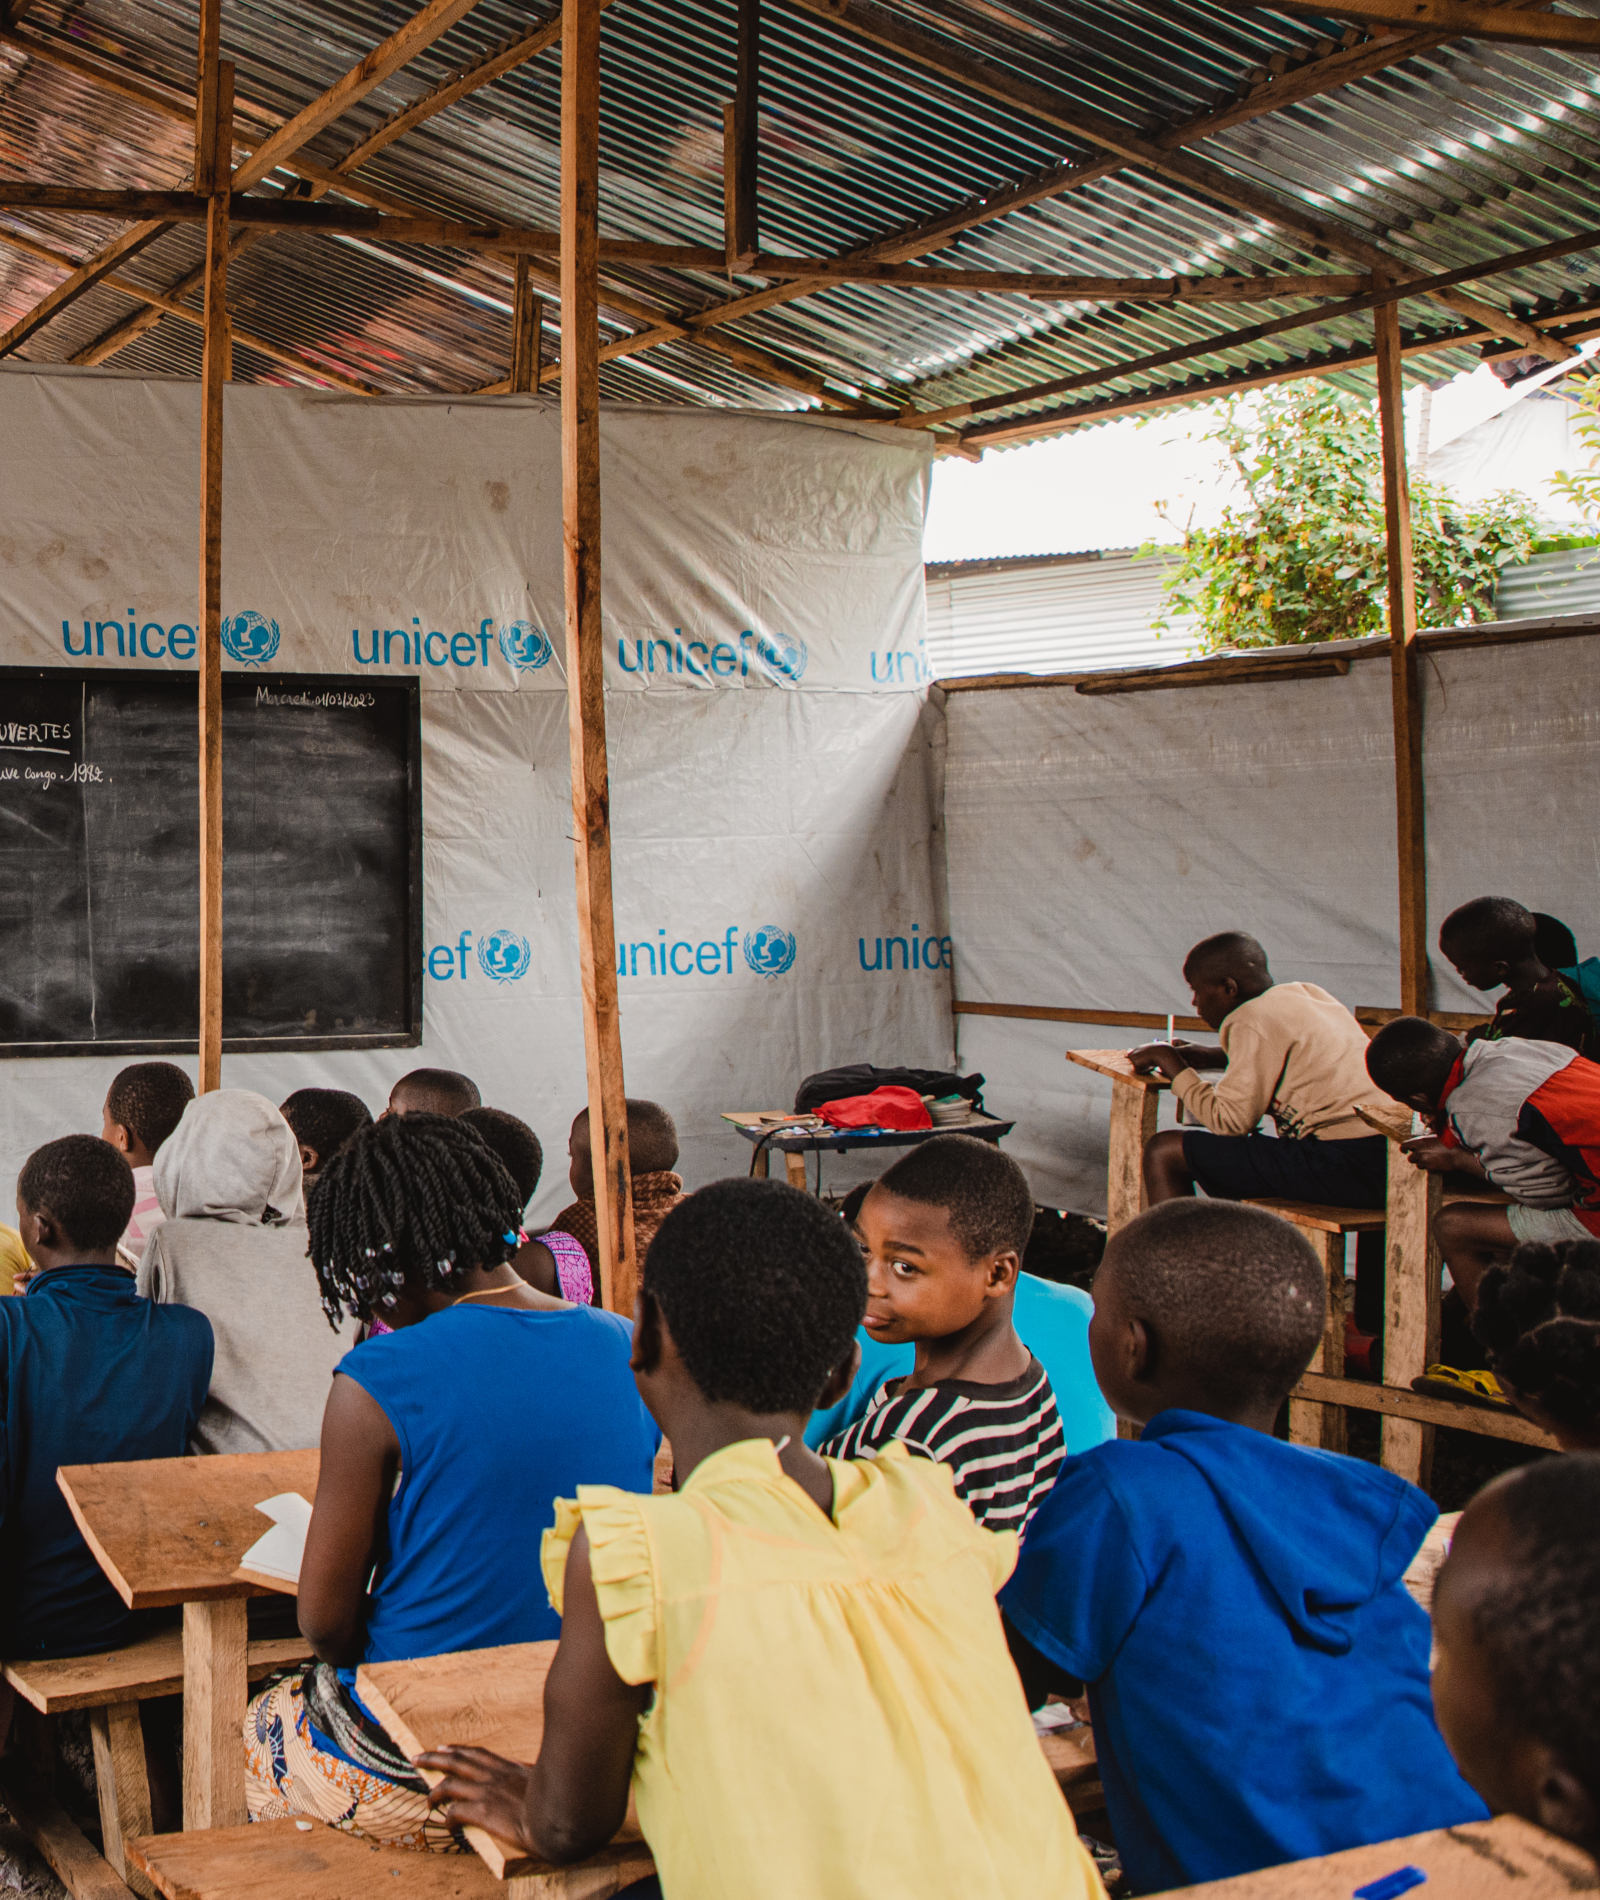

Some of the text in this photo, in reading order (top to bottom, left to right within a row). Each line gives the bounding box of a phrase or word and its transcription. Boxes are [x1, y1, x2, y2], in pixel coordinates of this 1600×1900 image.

[61, 608, 200, 661] unice
[352, 618, 495, 667] unicef
[618, 628, 753, 678] unicef
